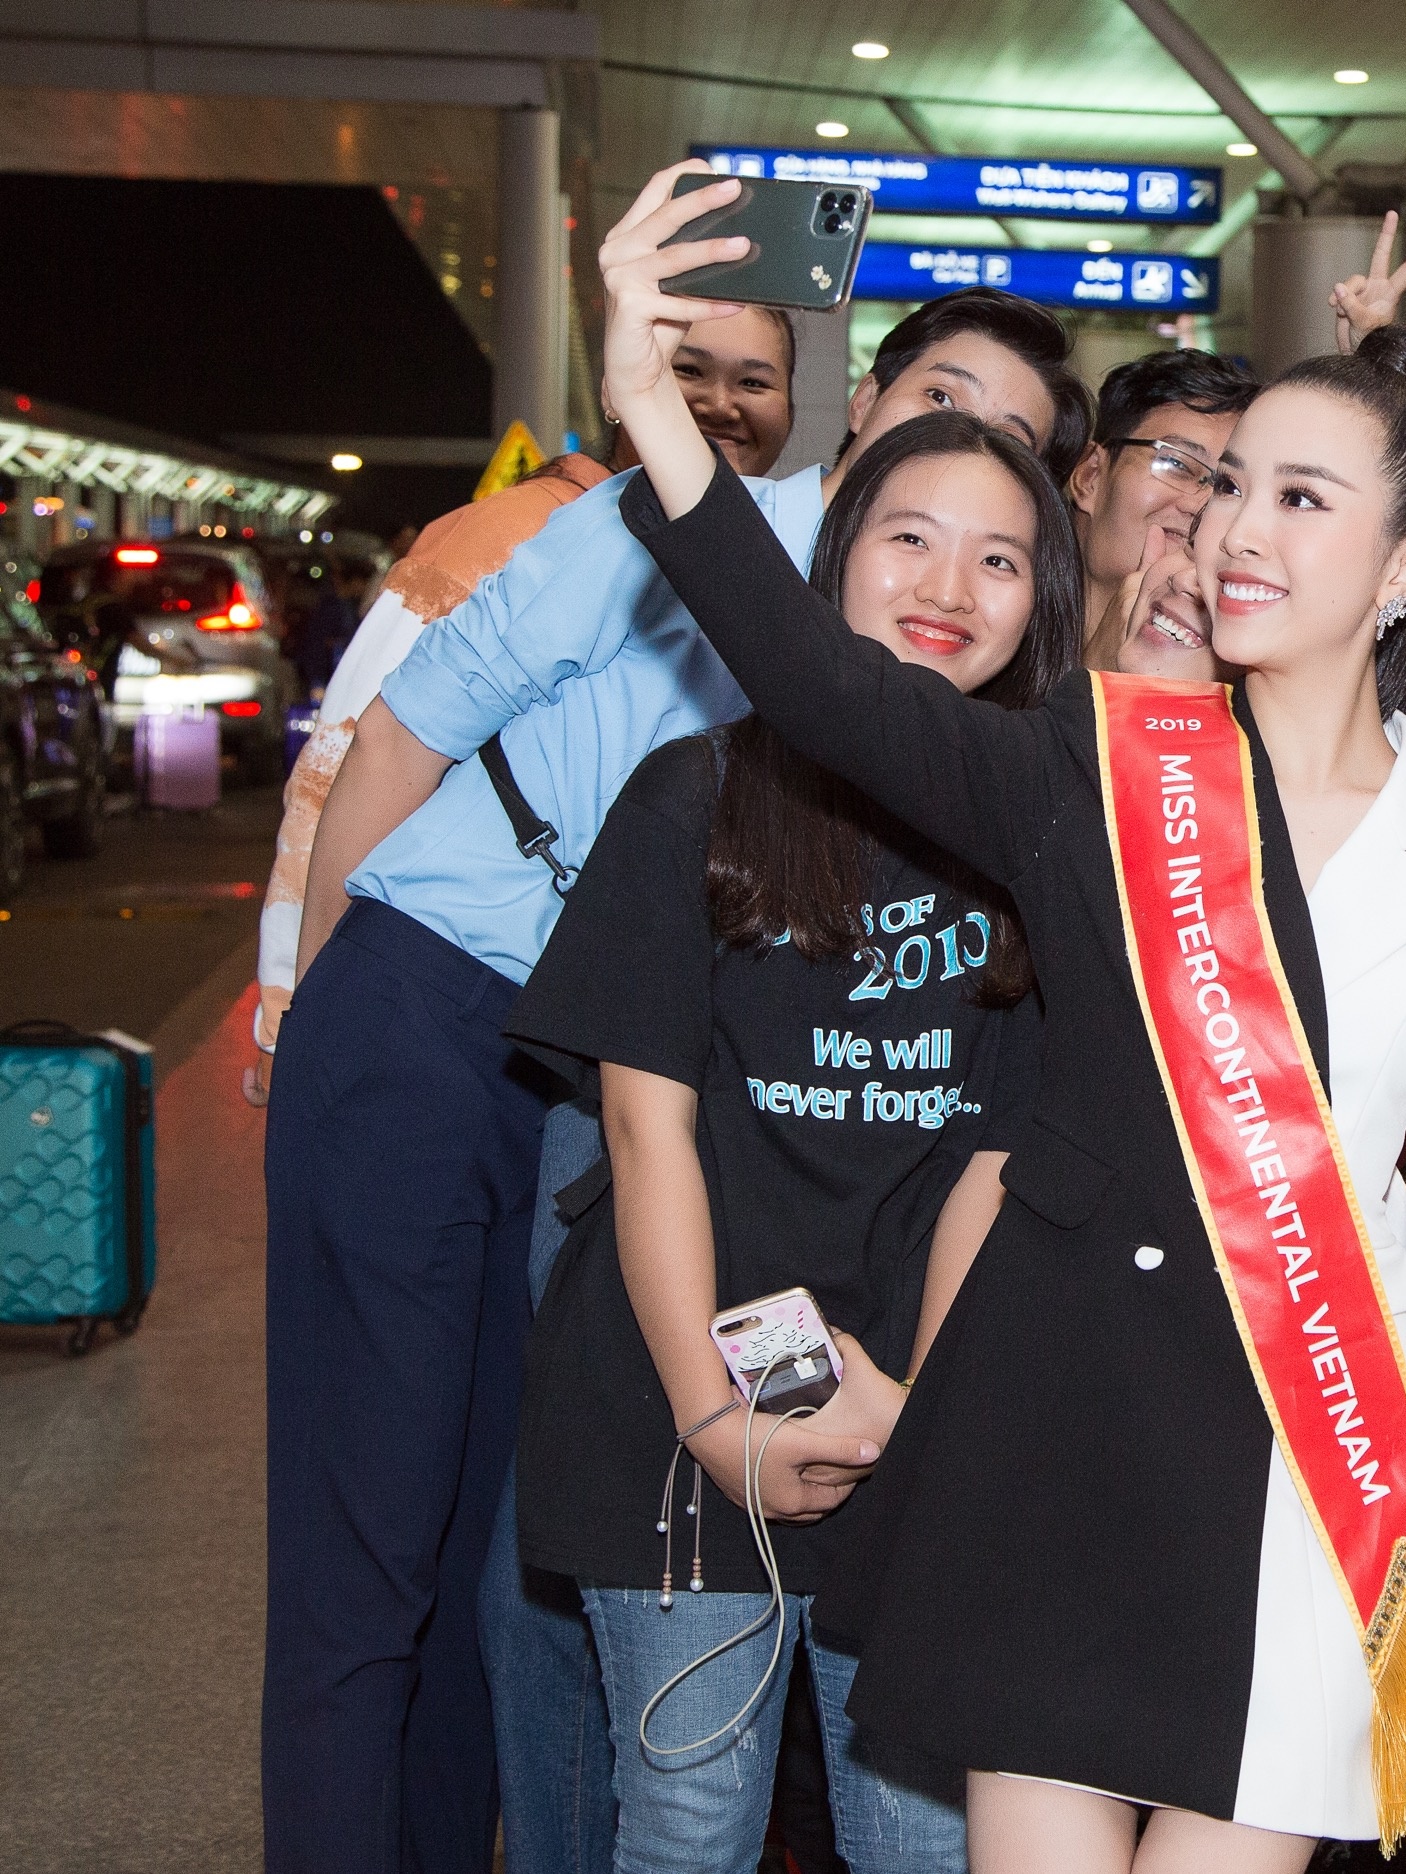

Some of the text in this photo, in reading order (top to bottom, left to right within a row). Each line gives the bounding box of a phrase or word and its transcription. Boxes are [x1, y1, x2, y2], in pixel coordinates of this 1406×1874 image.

[1144, 716, 1202, 732] 2019
[812, 1027, 952, 1070] We will
[746, 1077, 852, 1121] never
[1158, 754, 1391, 1506] MISS INTERCONTINENTAL VIETNAM
